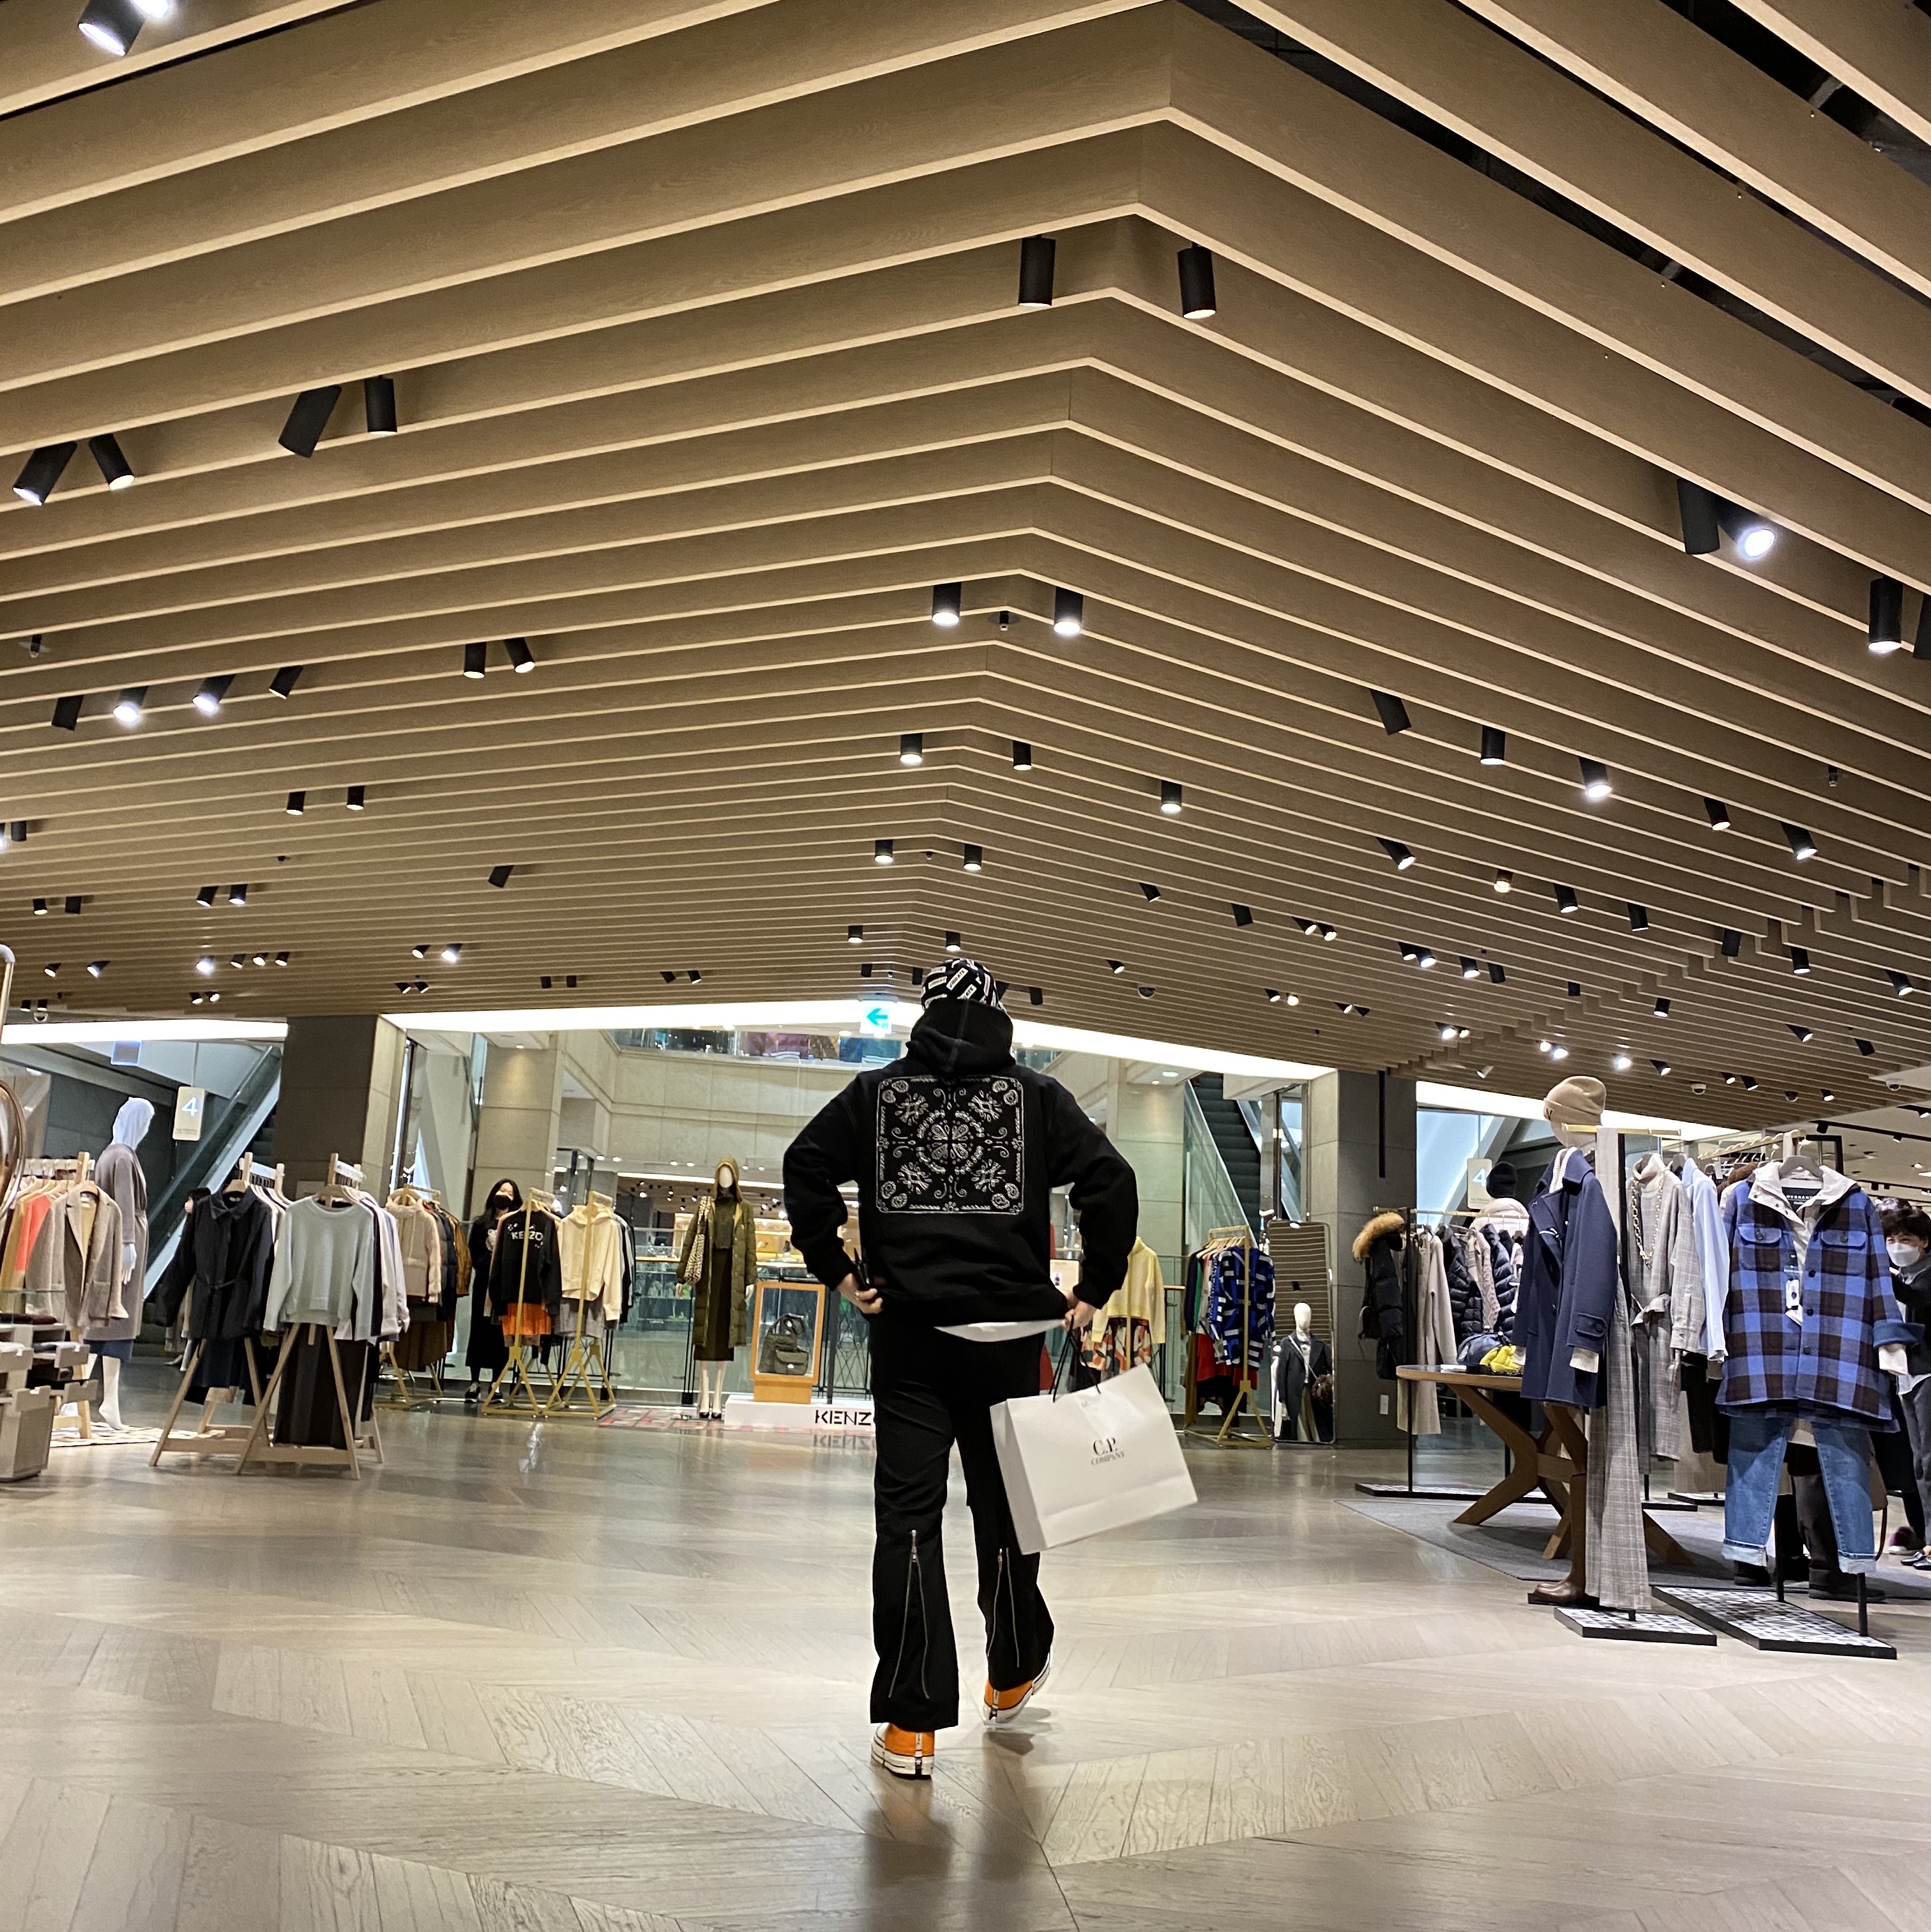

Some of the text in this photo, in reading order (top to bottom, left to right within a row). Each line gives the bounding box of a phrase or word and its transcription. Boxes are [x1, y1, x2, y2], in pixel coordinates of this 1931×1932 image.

[181, 1097, 198, 1116] 4
[1473, 1168, 1487, 1187] 4
[511, 1231, 543, 1241] KEZO
[815, 1410, 872, 1426] KENZ
[1093, 1437, 1118, 1456] C.P.
[1091, 1450, 1125, 1466] COMPANY
